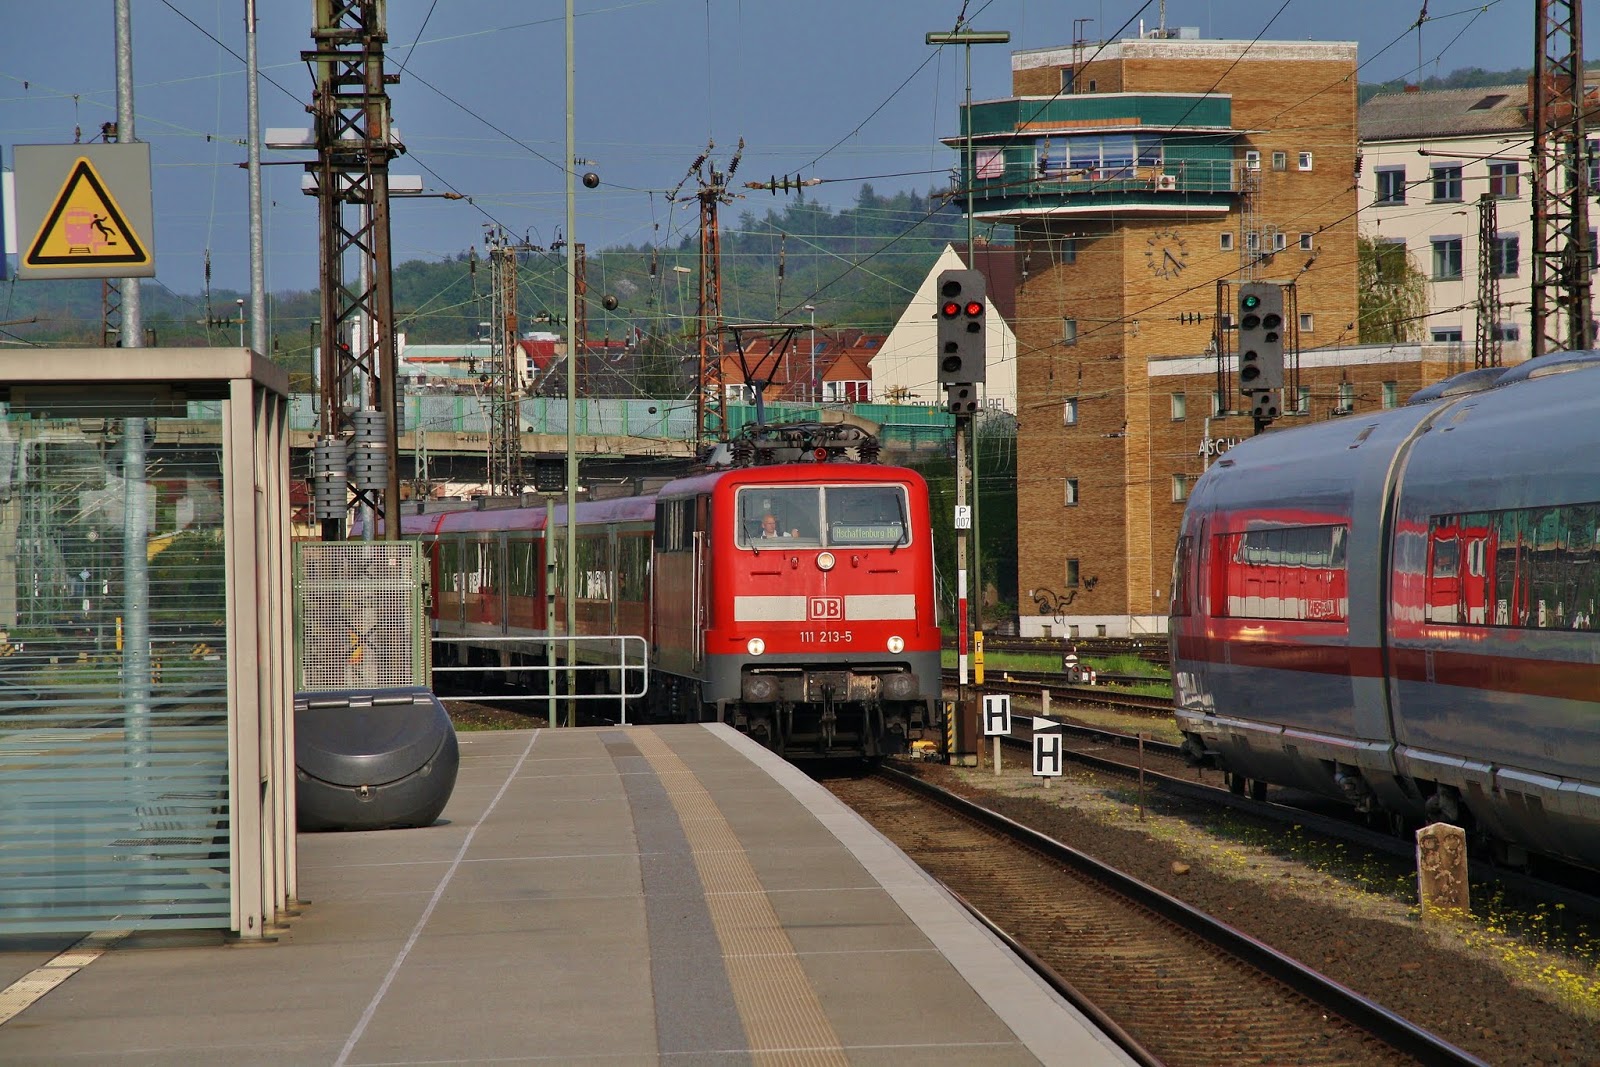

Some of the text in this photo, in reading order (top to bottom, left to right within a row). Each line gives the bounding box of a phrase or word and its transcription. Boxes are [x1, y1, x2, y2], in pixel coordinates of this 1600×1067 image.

[1198, 438, 1243, 455] ASCH
[959, 507, 967, 517] P
[956, 517, 970, 528] 007
[836, 527, 899, 538] Aschaffenburg Hbf
[813, 600, 838, 616] DB
[800, 630, 852, 643] 111 213-5
[976, 641, 982, 652] F
[986, 698, 1008, 731] H
[1036, 737, 1059, 772] H
